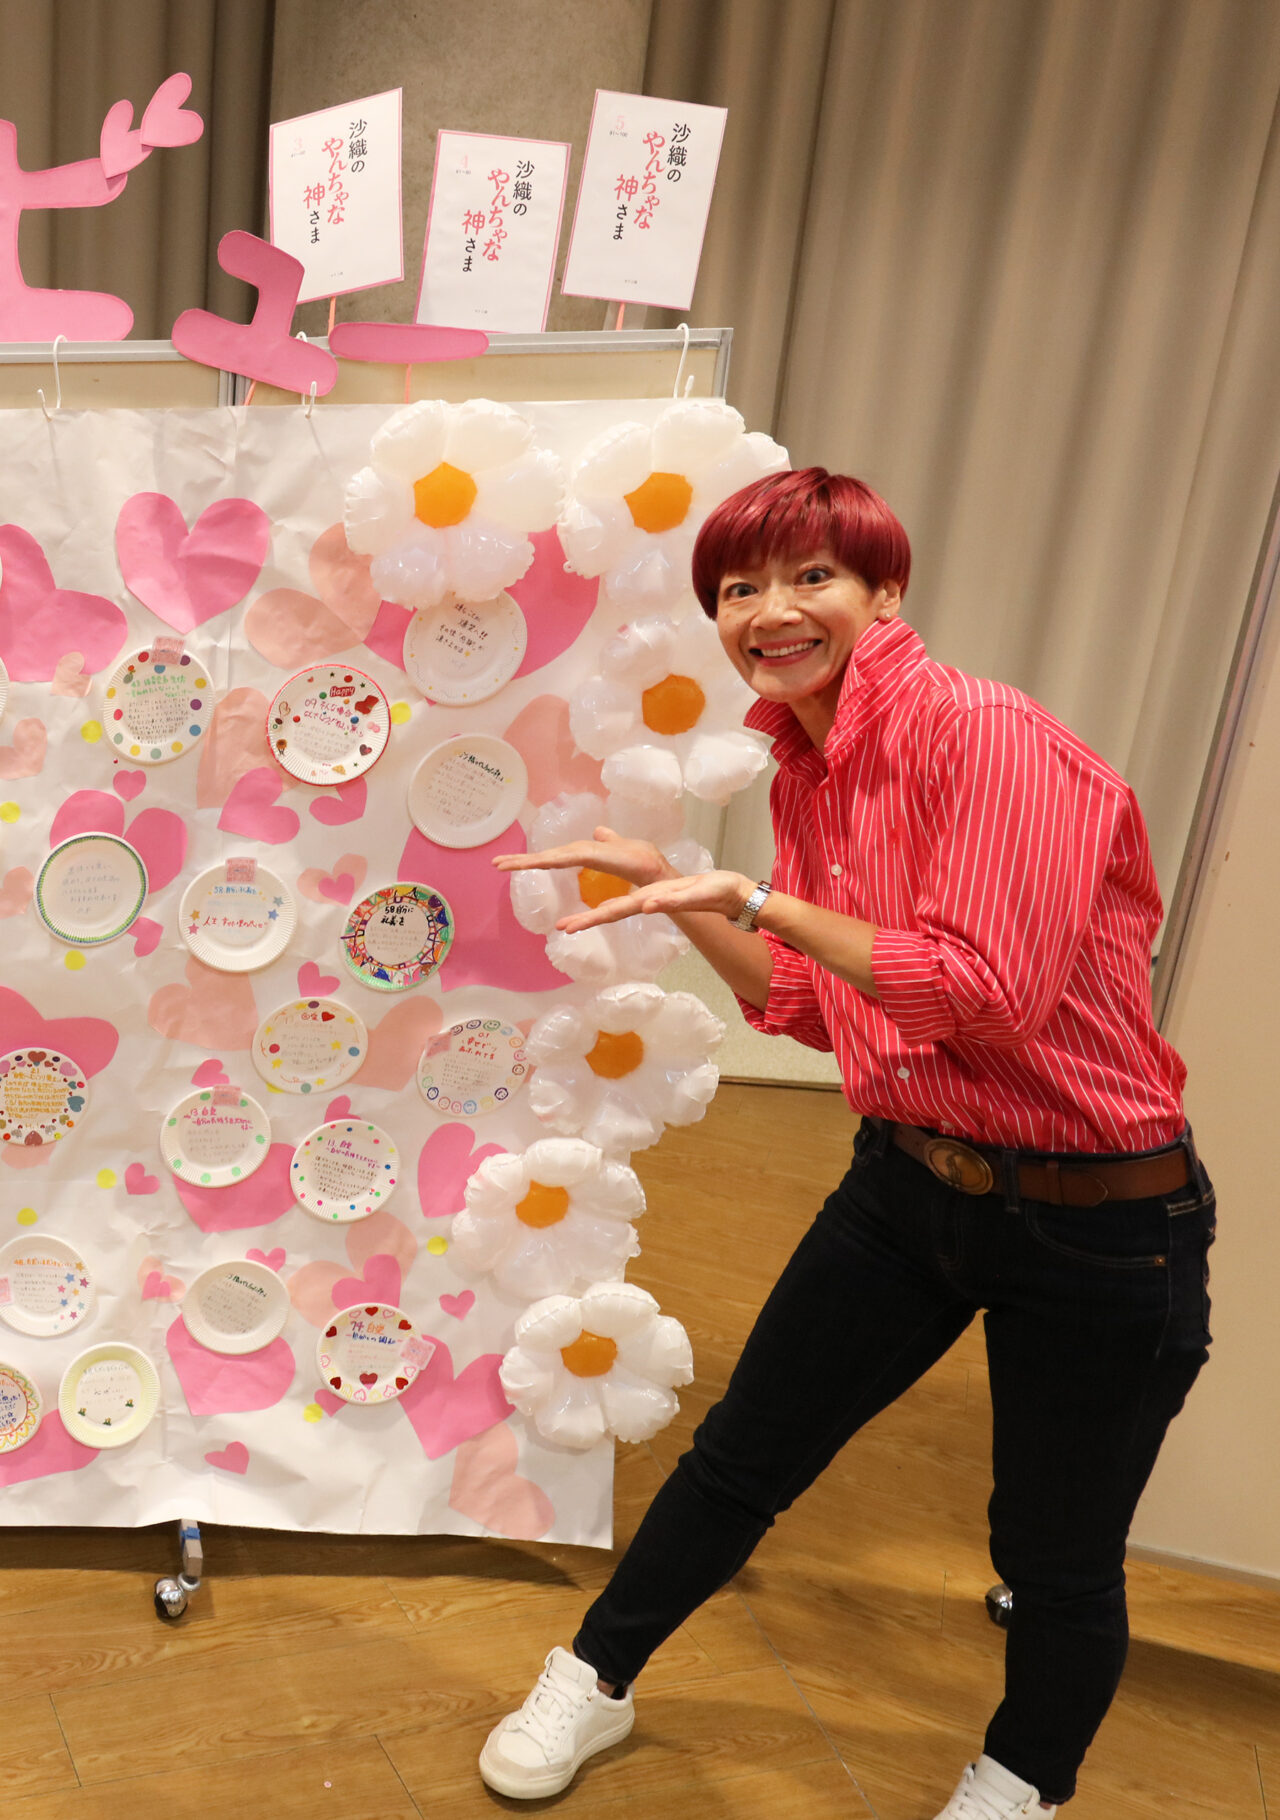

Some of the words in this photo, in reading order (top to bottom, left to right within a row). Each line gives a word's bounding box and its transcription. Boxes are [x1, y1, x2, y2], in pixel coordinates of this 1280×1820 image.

[348, 118, 368, 173] 沙織の
[667, 123, 691, 182] 沙織の
[321, 137, 349, 224] やんちゃな
[513, 160, 535, 216] 沙織の
[613, 174, 639, 240] 神さま
[633, 131, 665, 229] やんちゃな
[303, 182, 326, 244] 神さま
[461, 209, 486, 272] 神さま
[482, 168, 511, 261] やんちゃな
[330, 687, 355, 697] Happy
